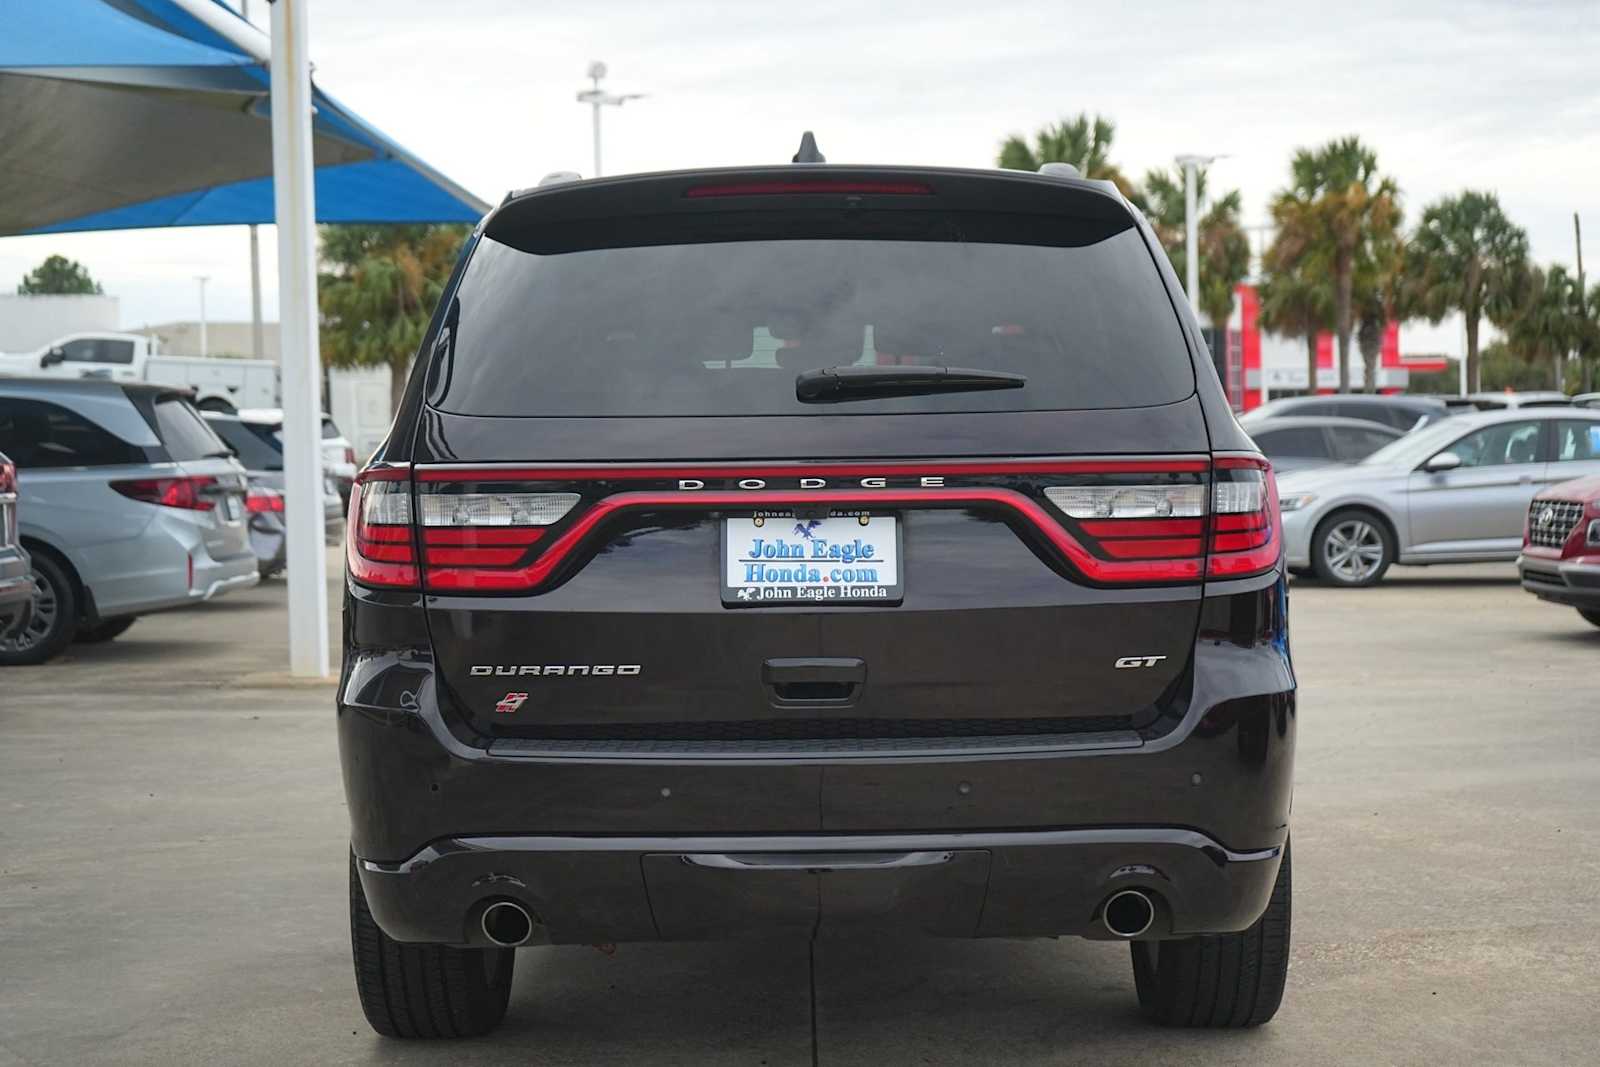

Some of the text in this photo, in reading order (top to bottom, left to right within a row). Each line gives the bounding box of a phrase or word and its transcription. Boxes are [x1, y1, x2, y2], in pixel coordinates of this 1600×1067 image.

[678, 477, 945, 490] DODGE
[748, 539, 875, 564] John Eagle
[744, 563, 878, 583] Honda.com
[756, 585, 887, 600] John Eagle Honda
[1115, 655, 1167, 668] GT
[470, 665, 641, 676] DURANGO
